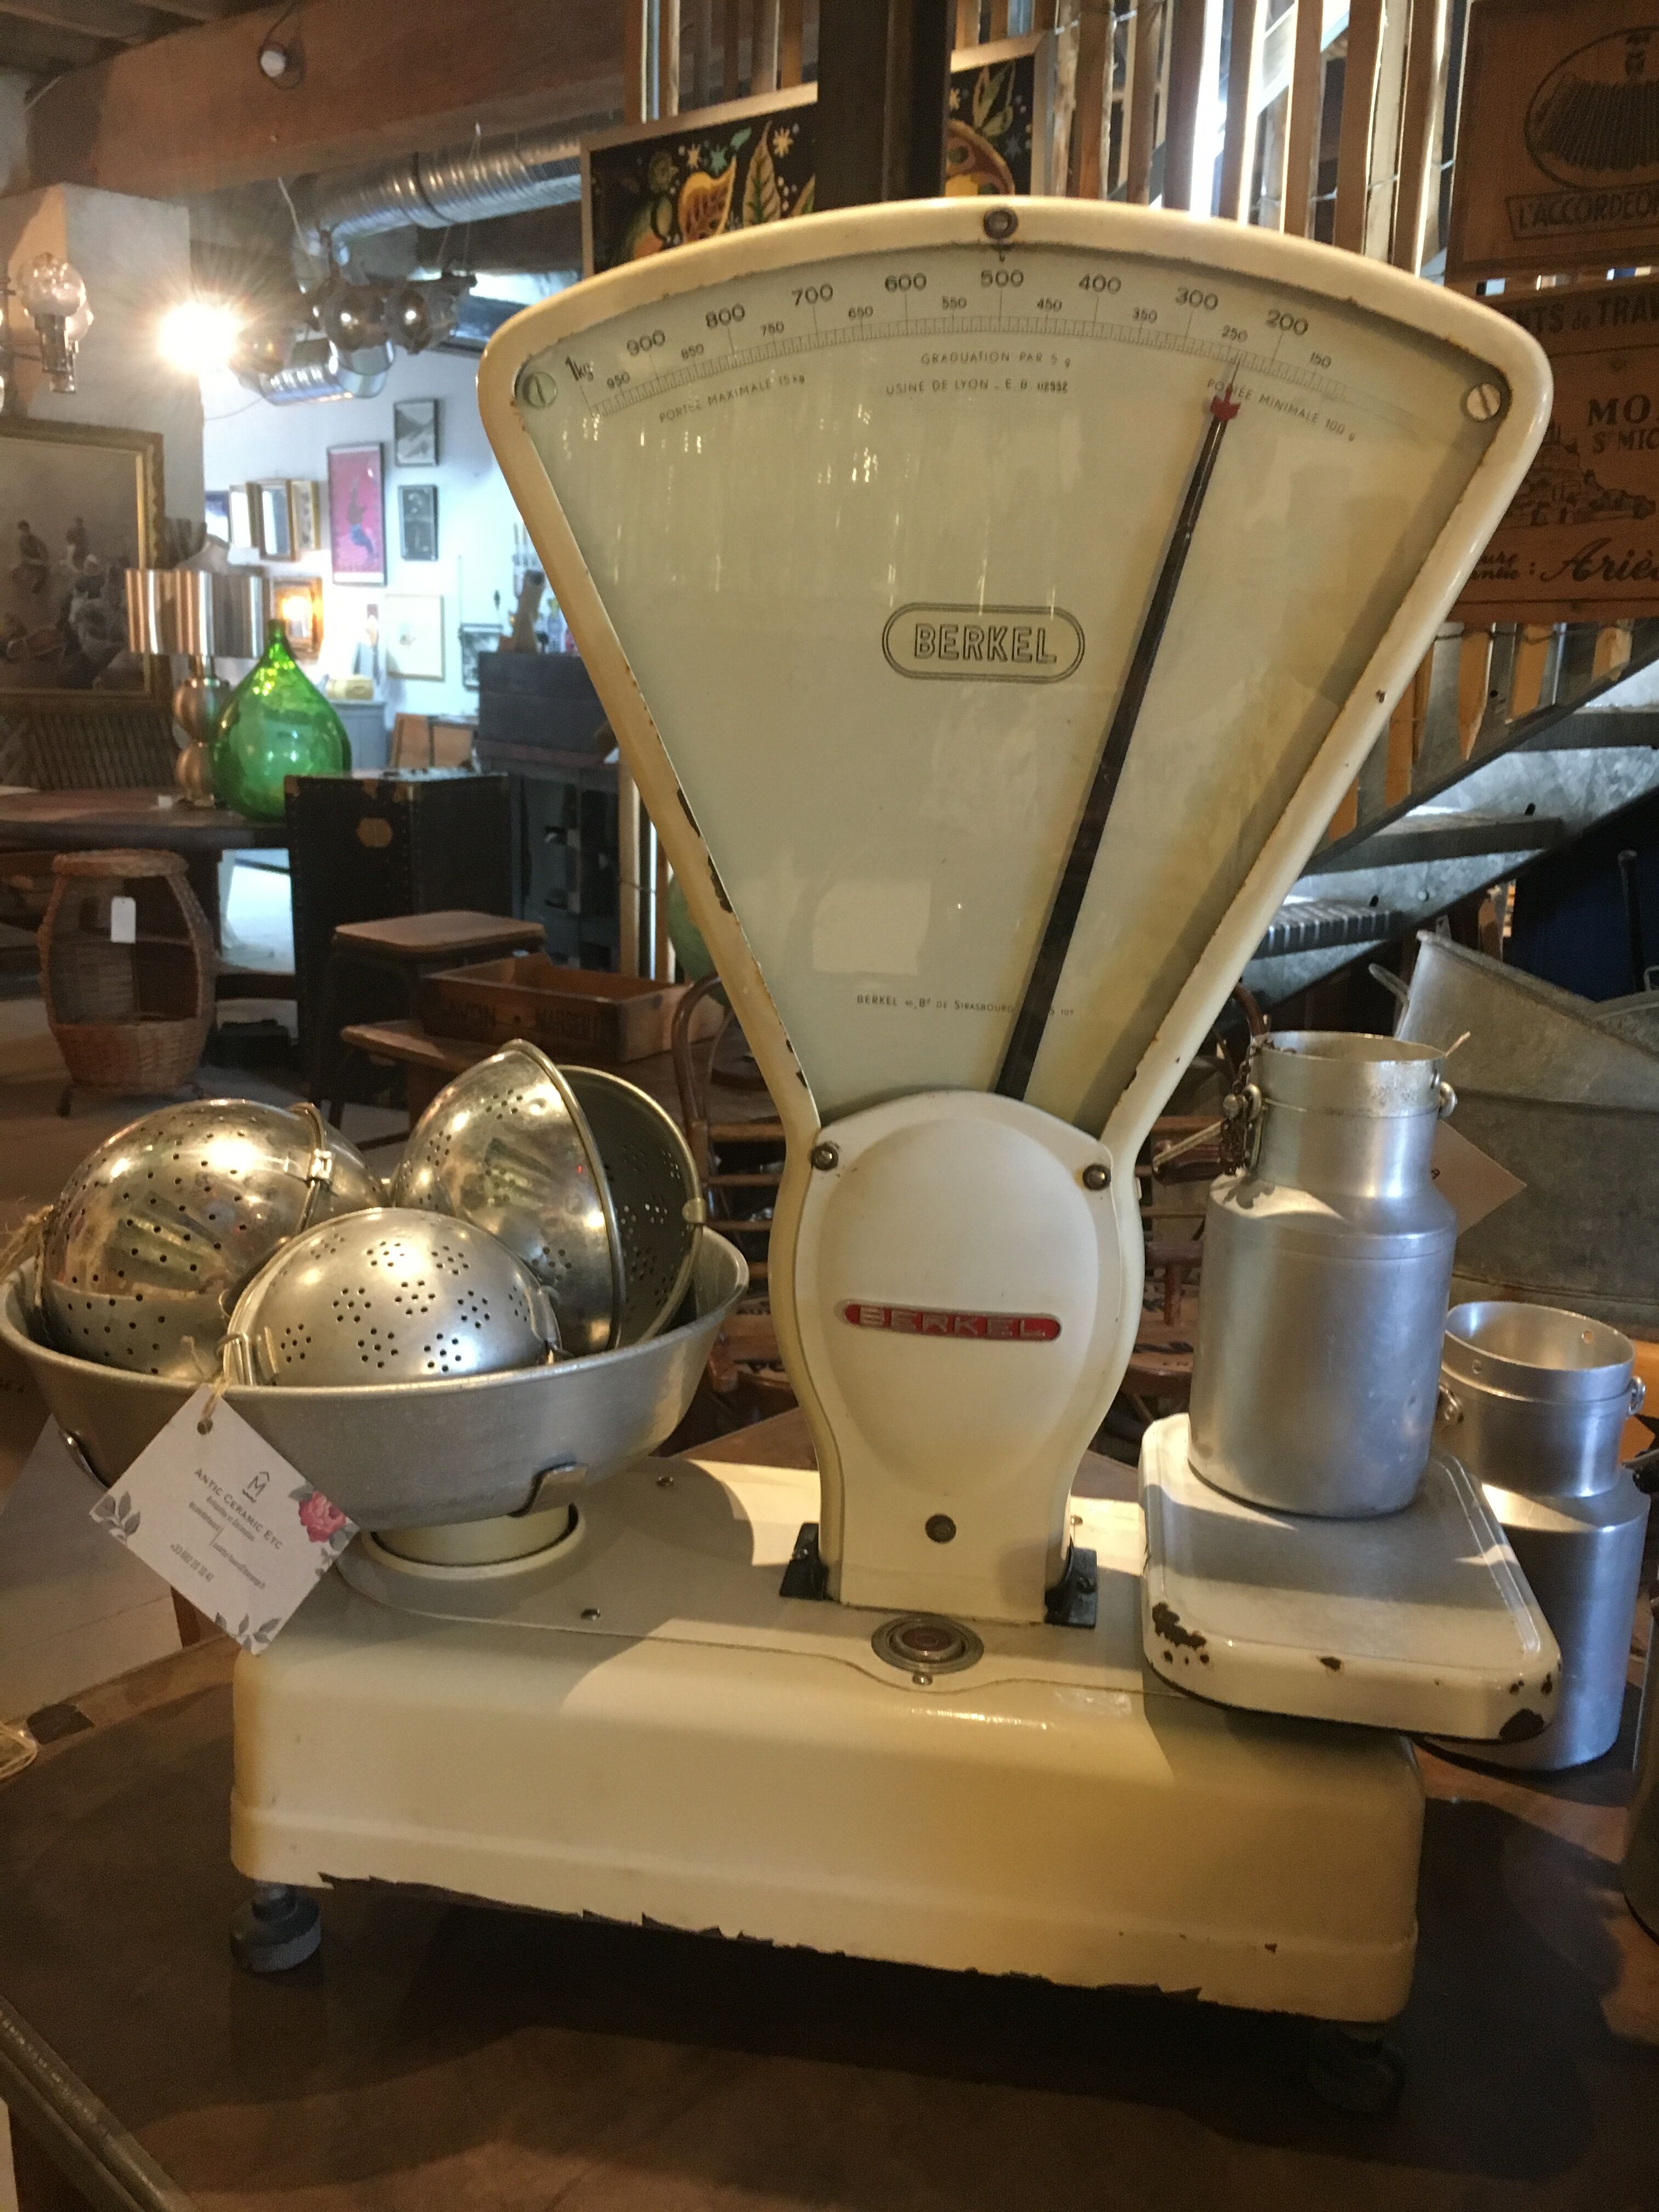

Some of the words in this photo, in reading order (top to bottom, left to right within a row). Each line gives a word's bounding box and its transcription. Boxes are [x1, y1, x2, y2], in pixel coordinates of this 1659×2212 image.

[626, 329, 665, 356] 900
[706, 303, 745, 328] 800
[791, 283, 833, 306] 700
[885, 272, 927, 292] 600
[980, 269, 1024, 288] 500
[1079, 273, 1122, 295] 400
[1175, 286, 1219, 311] 300
[1265, 308, 1308, 336] 200
[607, 371, 630, 389] 950
[680, 343, 704, 359] 850
[760, 321, 785, 336] 750
[848, 306, 873, 319] 650
[941, 296, 967, 310] 550
[1036, 297, 1062, 312] 450
[1132, 307, 1158, 324] 350
[1221, 325, 1248, 342] 250
[1310, 352, 1331, 369] 150
[921, 351, 1009, 365] GRADUATION
[1019, 352, 1043, 363] PAR
[1050, 353, 1058, 365] 5
[708, 379, 772, 406] MAXIMALE
[885, 381, 925, 396] USINE
[932, 379, 948, 391] DE
[955, 378, 989, 390] LYON
[1207, 378, 1254, 400] POTÉE
[1259, 393, 1319, 424] MINIMALE
[1325, 418, 1345, 435] 100
[1587, 394, 1659, 426] MO
[915, 623, 1057, 664] BERKEL
[857, 994, 898, 1006] BERKEL
[936, 1001, 947, 1009] DE
[859, 1305, 1046, 1339] BERKEL
